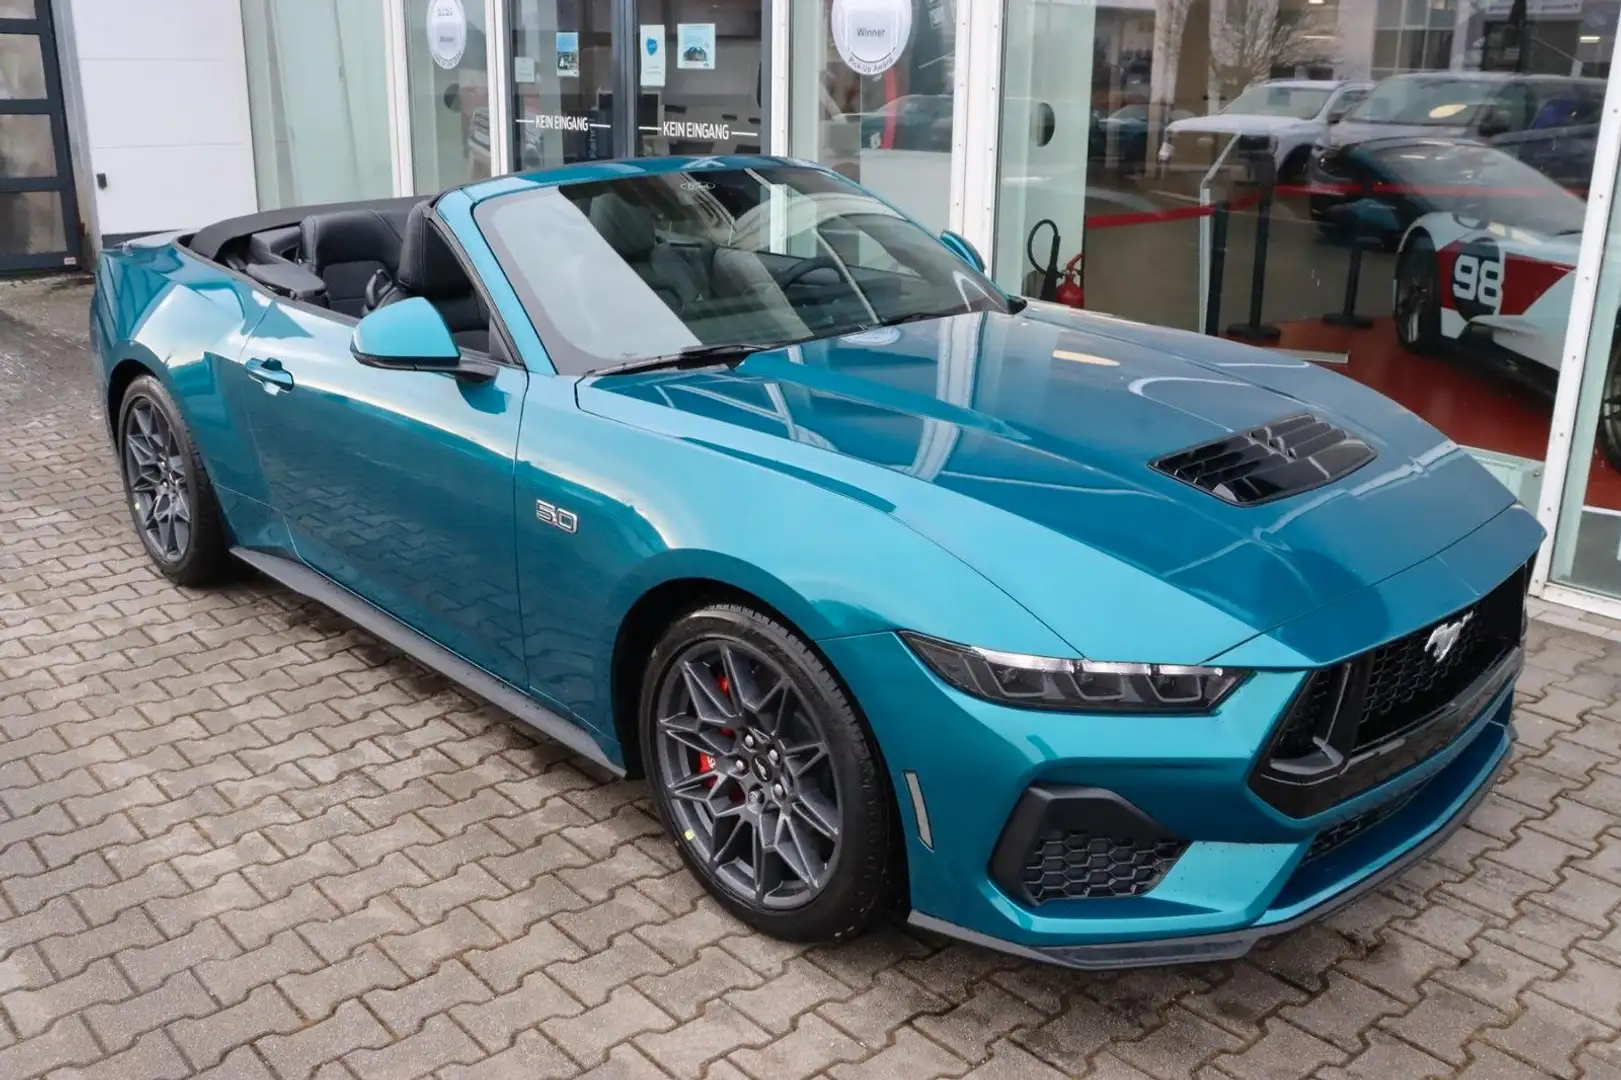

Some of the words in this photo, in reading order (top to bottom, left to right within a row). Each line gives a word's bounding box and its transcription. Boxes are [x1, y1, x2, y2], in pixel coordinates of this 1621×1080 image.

[857, 28, 885, 37] Winner
[535, 115, 554, 129] KEIN
[554, 116, 589, 131] EINGANG
[663, 121, 685, 137] KEIN
[686, 122, 729, 140] EINGANG
[1453, 254, 1504, 308] 98
